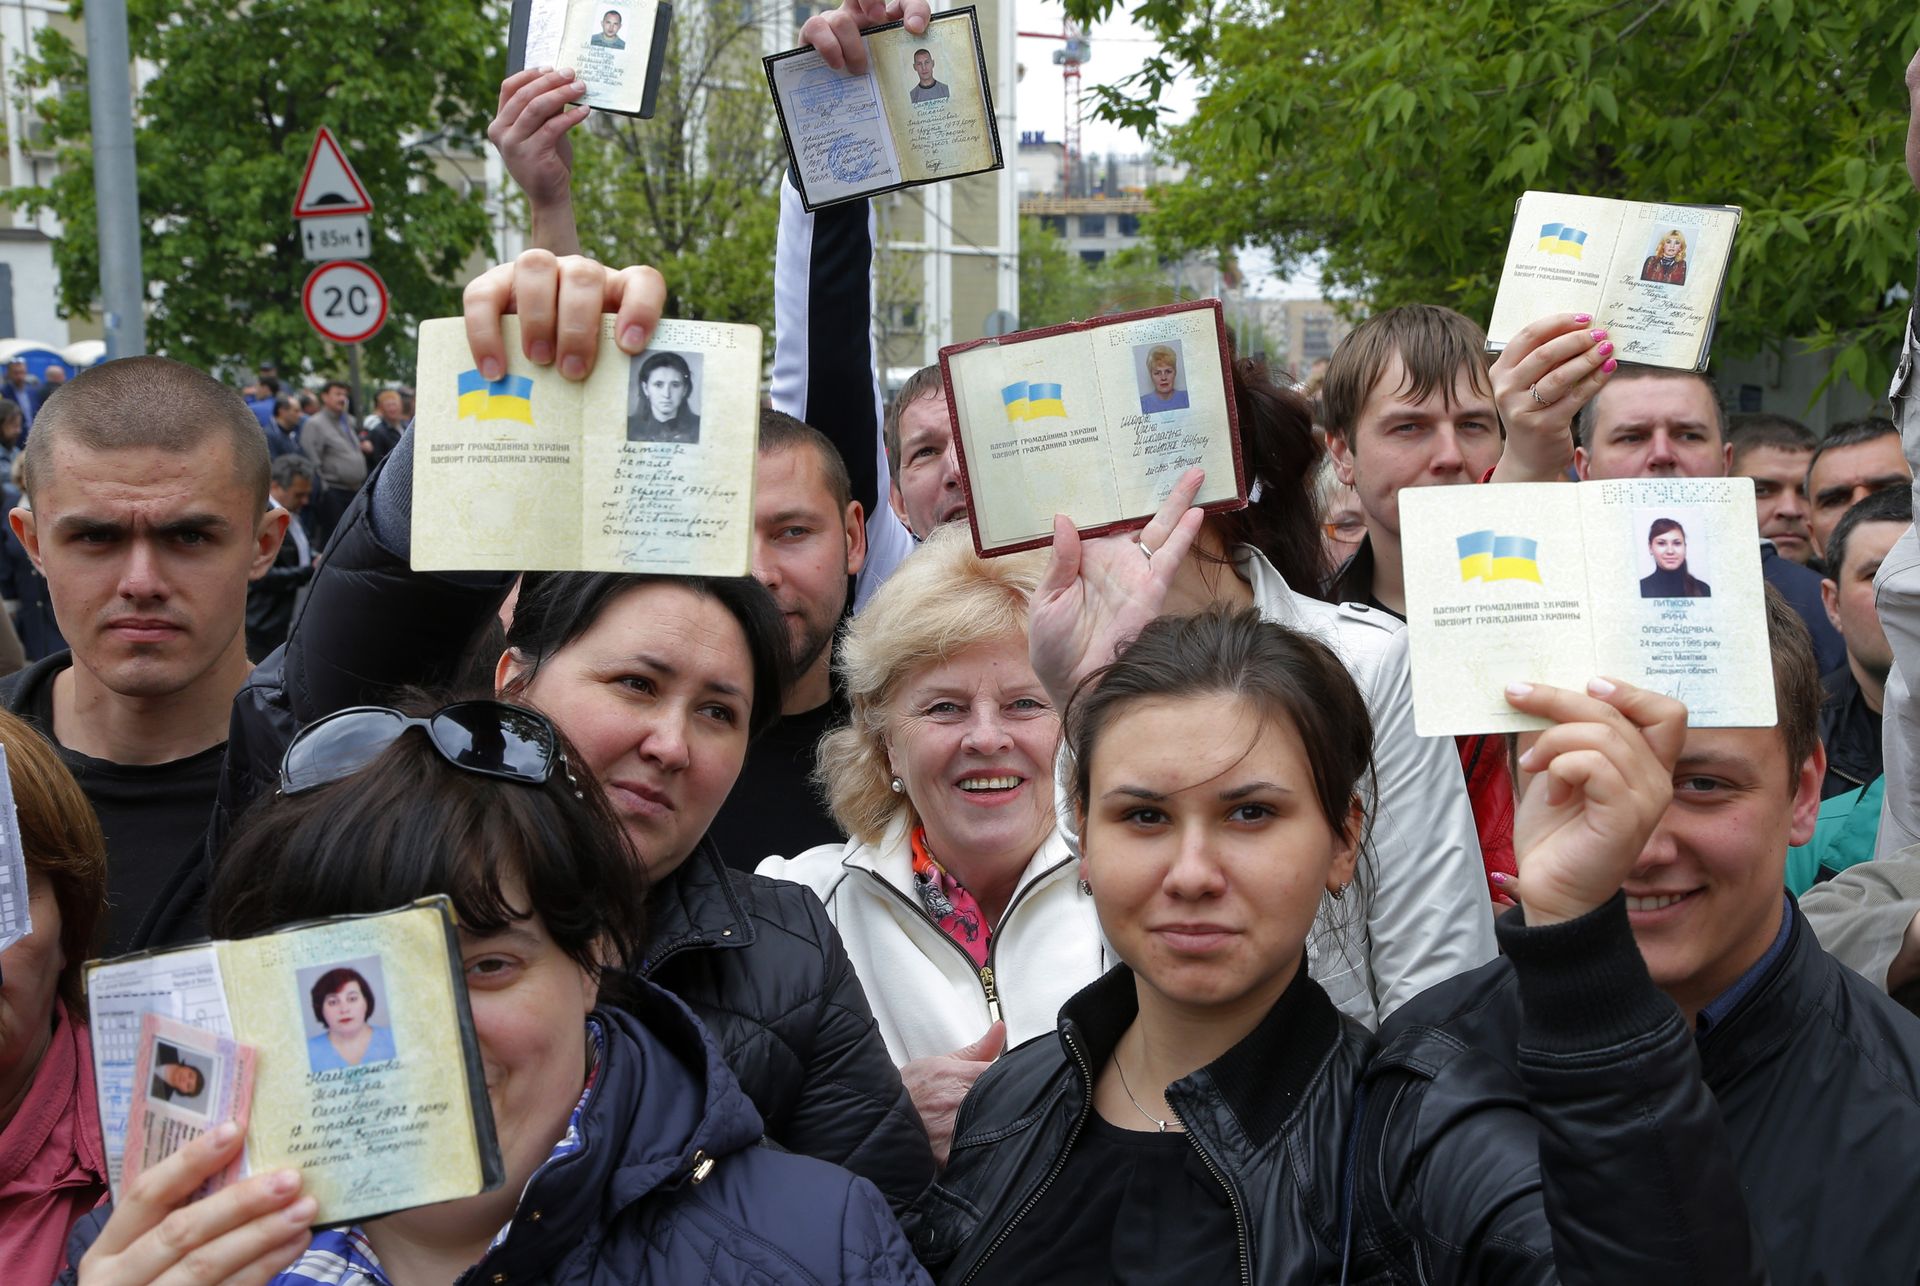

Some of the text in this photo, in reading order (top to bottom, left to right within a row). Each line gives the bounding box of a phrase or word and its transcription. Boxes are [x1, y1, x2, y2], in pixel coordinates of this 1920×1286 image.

[320, 229, 351, 247] 85м
[1515, 263, 1536, 272] ПАСПОРТ
[1513, 271, 1534, 280] ПАСПОРТ
[324, 285, 368, 317] 20
[990, 425, 1098, 450] ПАСПОРТ ГРОМАДЯНИНА УКРАЇНИ
[431, 442, 570, 452] ПАСПОРТ ГРОМАДЯНИНА УКРАЇНИ
[992, 435, 1099, 460] ПАСПОРТ ГРАЖДАНИНА УКРАИНЫ
[431, 454, 570, 465] ПАСПОРТ ГРАЖДАНИНА УКРАИНЫ
[1433, 599, 1580, 616] ПАСПОРТ ГРОМАДЯНИНА УКРАЇНИ
[1434, 610, 1581, 628] ПАСПОРТ ГРАЖДАНИНА УКРАИНЫ
[1642, 625, 1713, 634] ОЛЕКСАНДРІВНА
[1651, 640, 1680, 648] лютого
[1704, 640, 1721, 649] року
[1688, 666, 1718, 675] області
